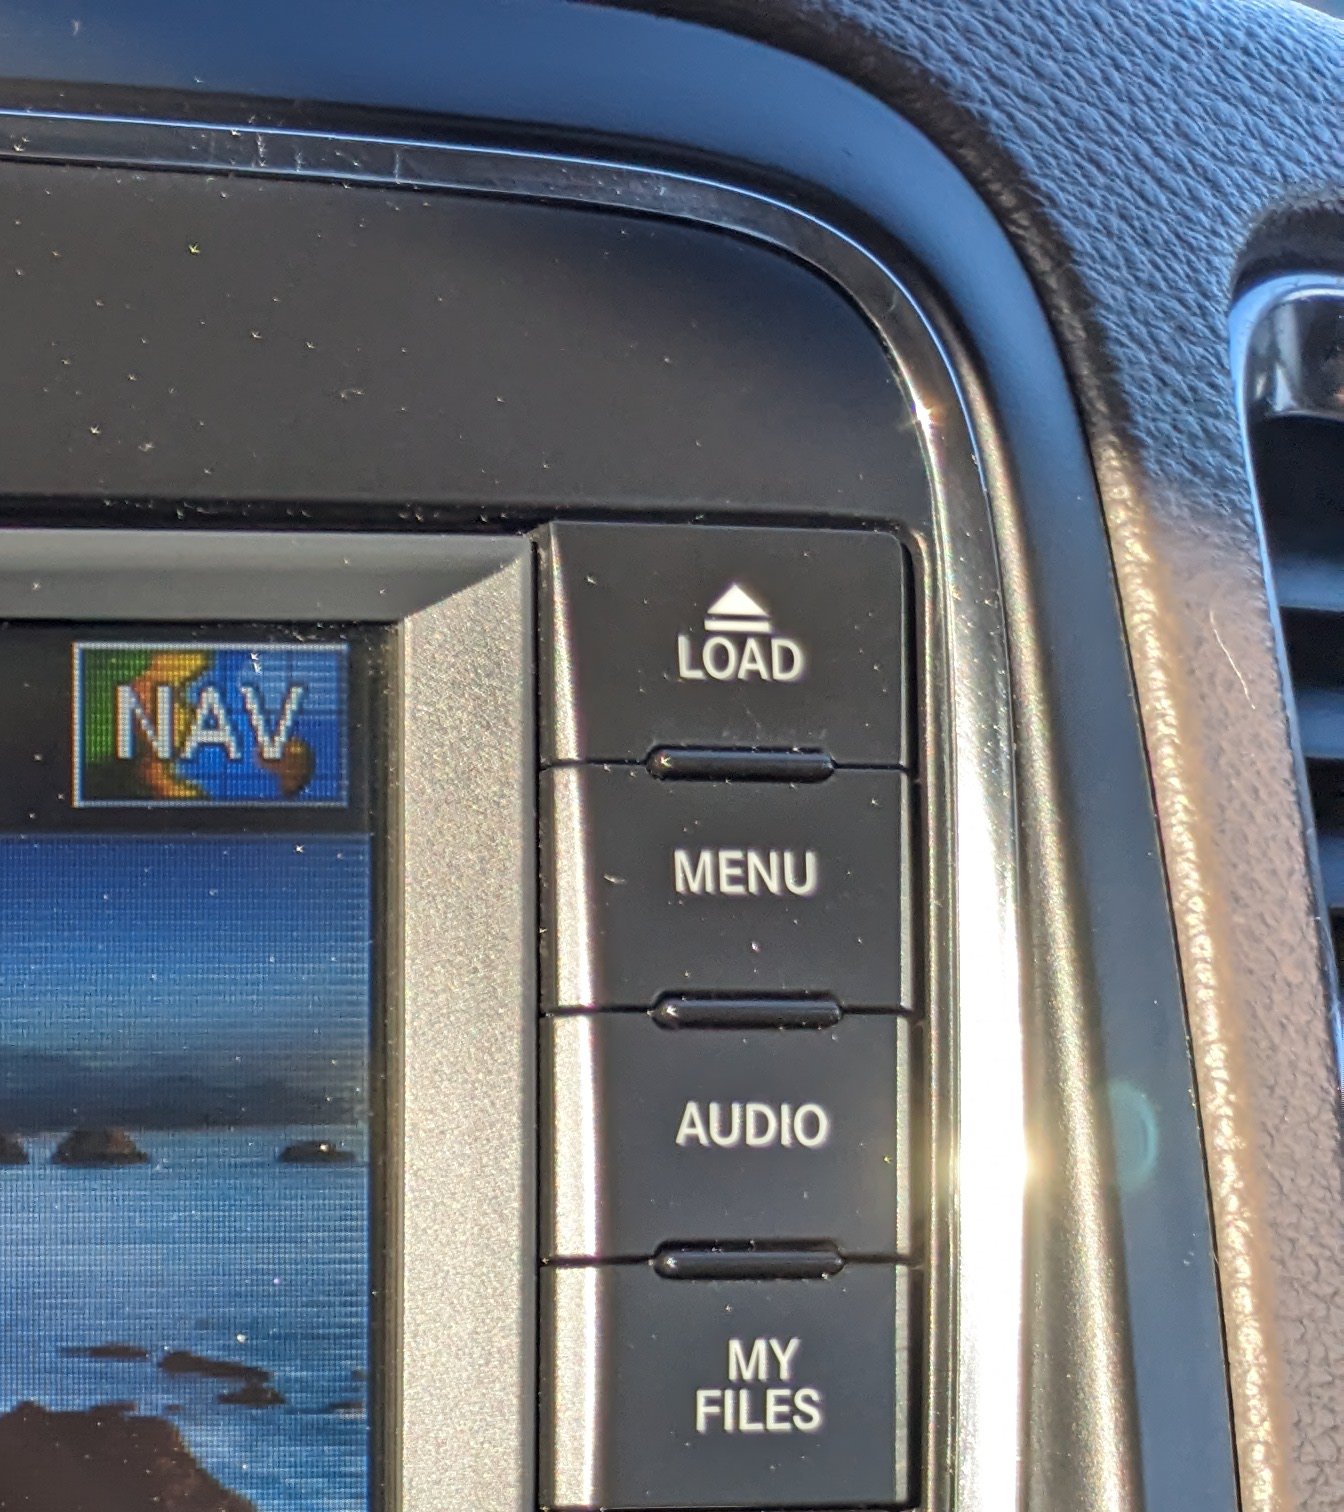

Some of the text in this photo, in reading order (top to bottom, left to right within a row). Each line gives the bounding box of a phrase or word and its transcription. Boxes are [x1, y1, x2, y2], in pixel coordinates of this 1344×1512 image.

[677, 634, 806, 681] LOAD
[116, 684, 306, 760] NAV
[673, 848, 817, 896] MENU
[676, 1102, 831, 1149] AUDIO
[728, 1338, 801, 1382] MY
[695, 1388, 824, 1433] FILES
